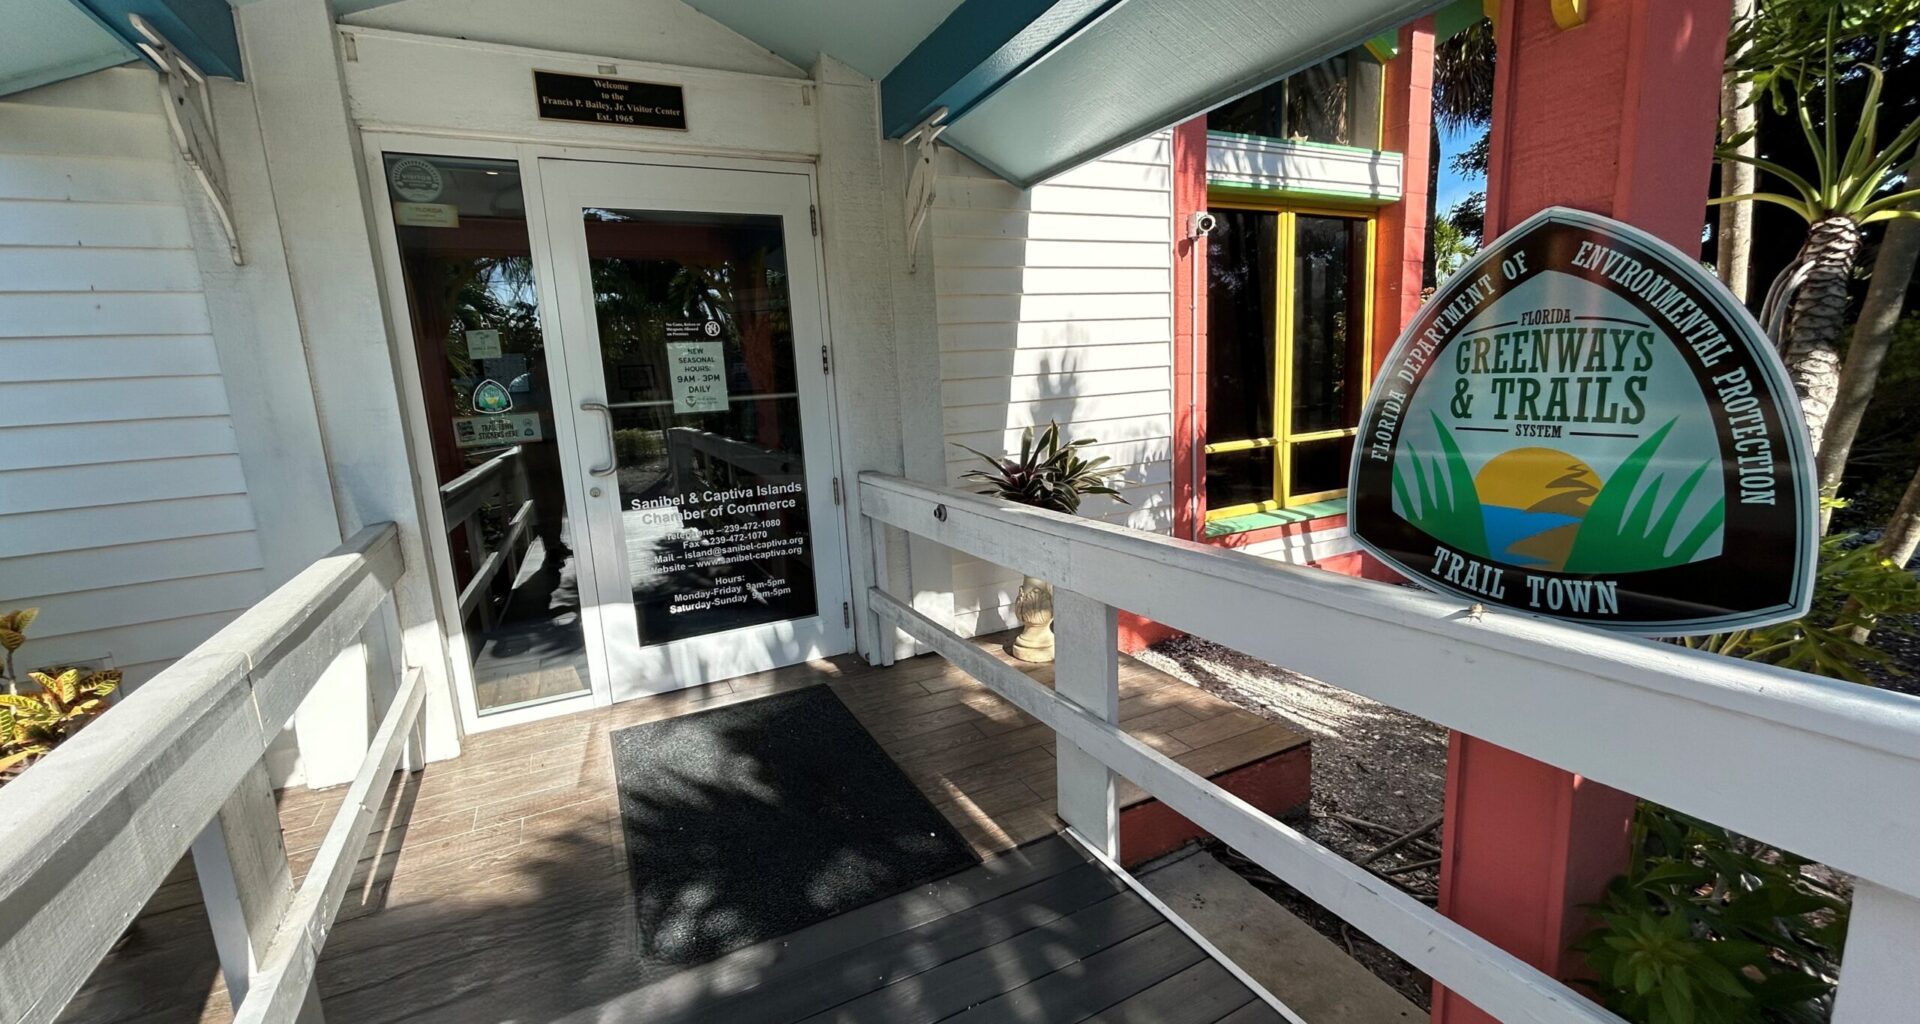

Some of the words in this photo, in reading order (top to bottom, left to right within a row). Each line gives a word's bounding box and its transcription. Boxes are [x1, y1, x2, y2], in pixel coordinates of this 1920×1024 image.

[593, 80, 629, 91] Welcome
[542, 96, 573, 107] Francis
[586, 101, 613, 111] Bailey,
[614, 103, 626, 111] Jr.
[626, 104, 653, 113] Visitor
[655, 107, 681, 116] Center
[611, 93, 624, 101] the
[596, 113, 612, 121] Est.
[615, 114, 634, 123] 1965
[1521, 309, 1571, 326] FLORIDA
[1456, 327, 1655, 375] GREENWAYS
[677, 375, 696, 383] 9AM
[702, 374, 720, 382] 3PM
[1371, 389, 1407, 462] FLORIDA
[1397, 274, 1496, 385] DEPARTMENT
[1502, 250, 1528, 281] OF
[1571, 240, 1734, 368] ENVIRONMENTAL
[1712, 366, 1775, 506] PROTECTION
[688, 385, 711, 393] DAILY
[1450, 377, 1473, 419] &
[1491, 375, 1648, 424] TRAILS
[1515, 424, 1563, 438] SYSTEM
[631, 494, 685, 510] Sanibel
[688, 492, 699, 504] &
[703, 487, 753, 502] Captiva
[757, 482, 802, 497] Islands
[642, 507, 706, 525] Chamber
[710, 505, 724, 518] of
[727, 498, 796, 515] Commerce
[724, 519, 781, 533] 239-472-1080
[683, 540, 700, 550] Fax
[709, 530, 768, 545] 239-472-1070
[685, 536, 804, 559] island@sanibel-captiva.org
[650, 562, 686, 575] Website
[674, 585, 742, 602] Monday-Friday
[746, 578, 785, 591] 9am-5pm
[715, 574, 746, 586] Hours:
[1431, 545, 1505, 600] TRAIL
[1526, 575, 1619, 615] TOWN
[669, 593, 748, 614] Saturday-Sunday
